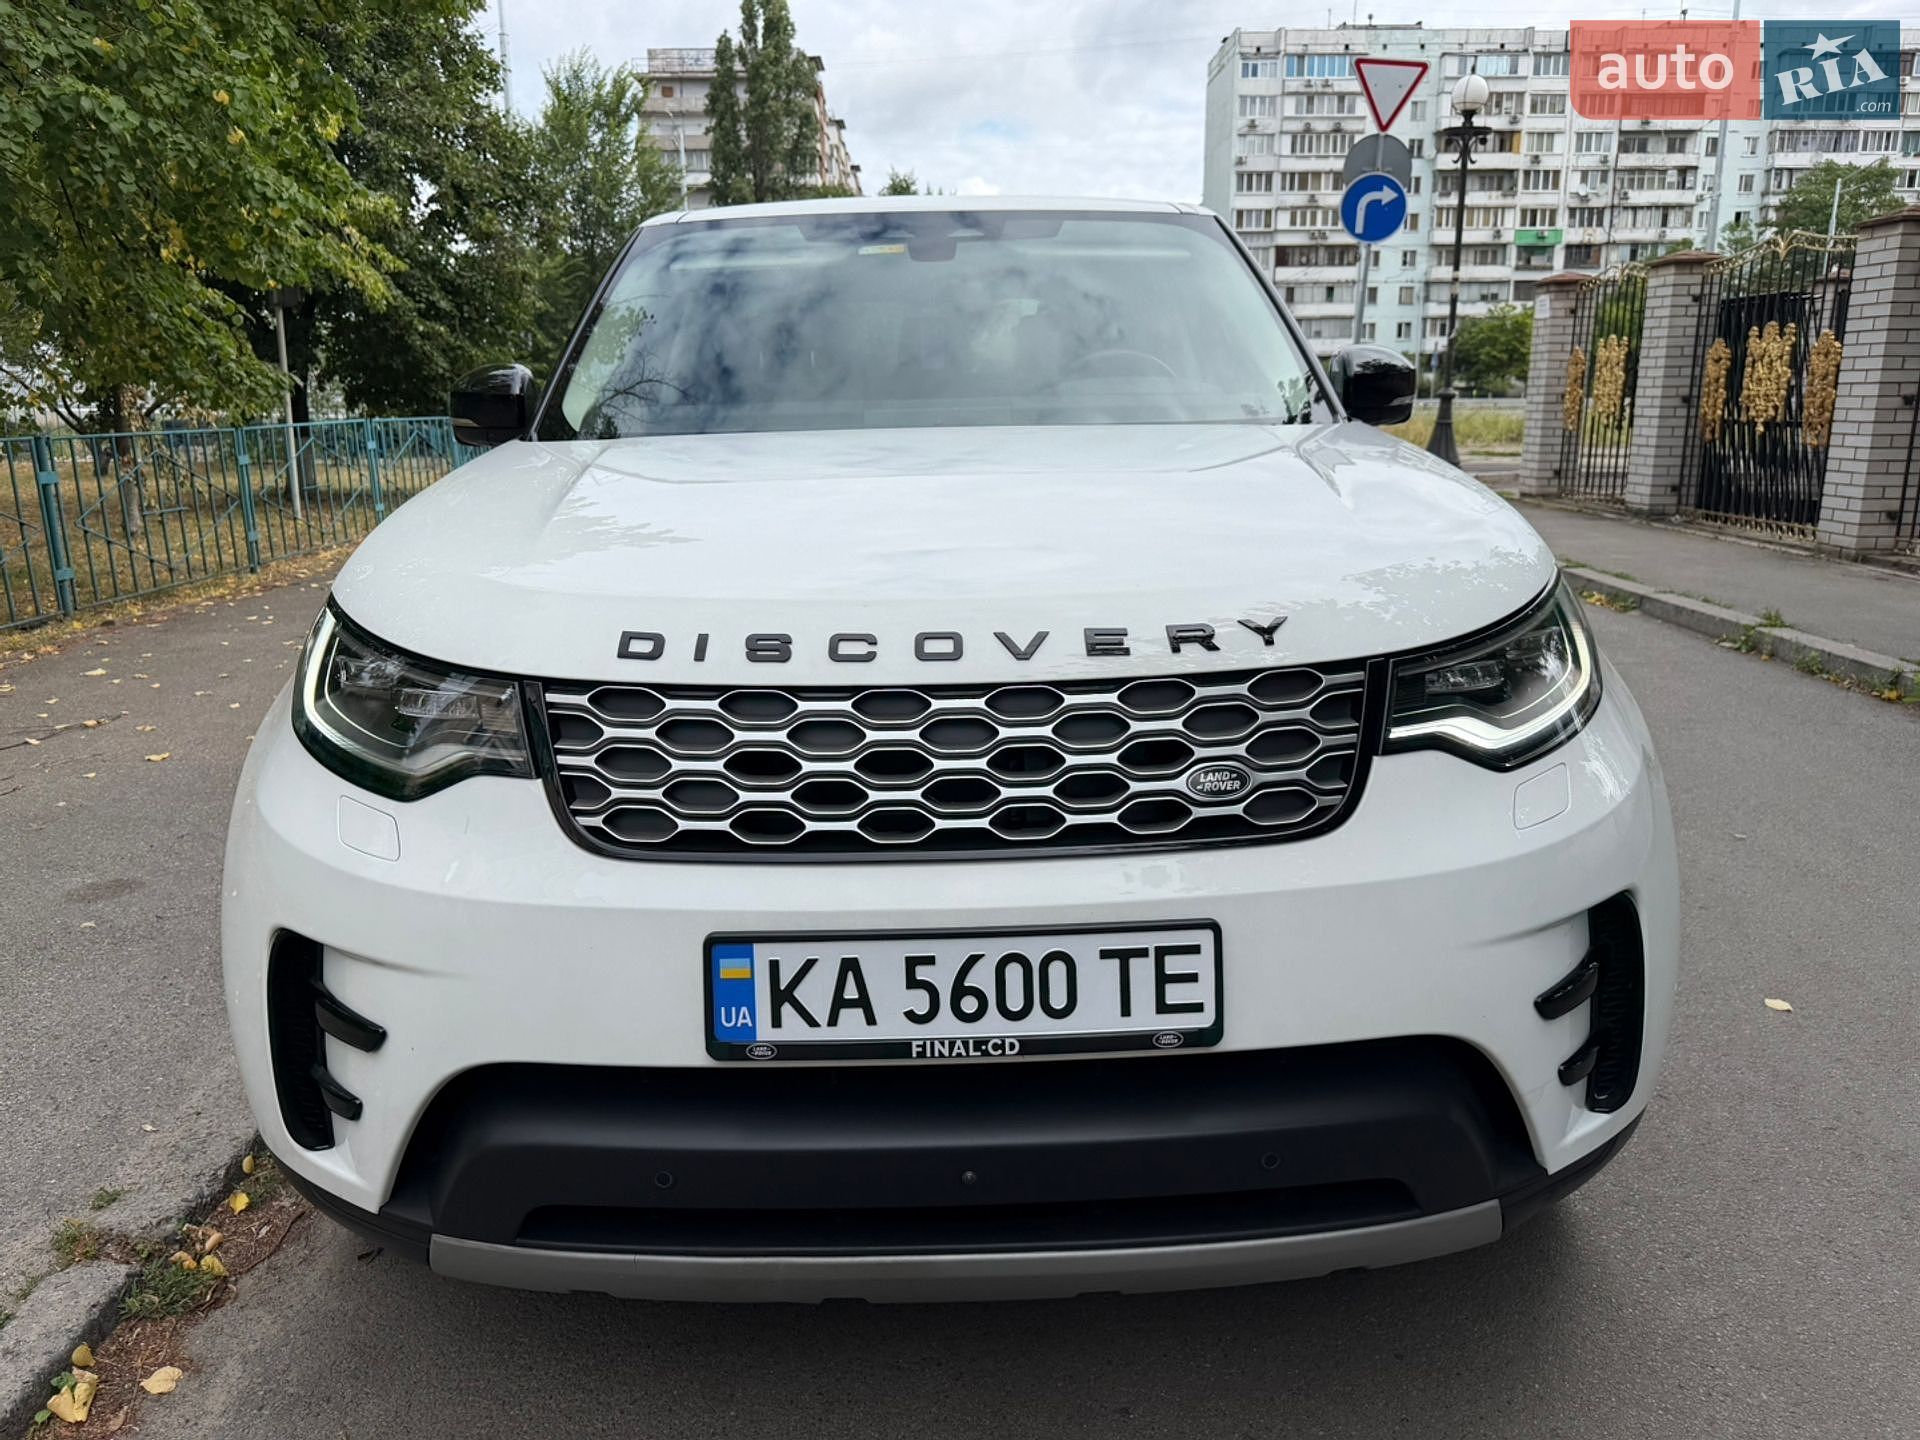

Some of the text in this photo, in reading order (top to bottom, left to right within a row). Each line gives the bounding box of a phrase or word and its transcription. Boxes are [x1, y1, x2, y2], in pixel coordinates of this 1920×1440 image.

[616, 615, 1288, 662] DISCOVERY
[768, 943, 1205, 1029] KA 5600 TE
[720, 1006, 753, 1029] UA
